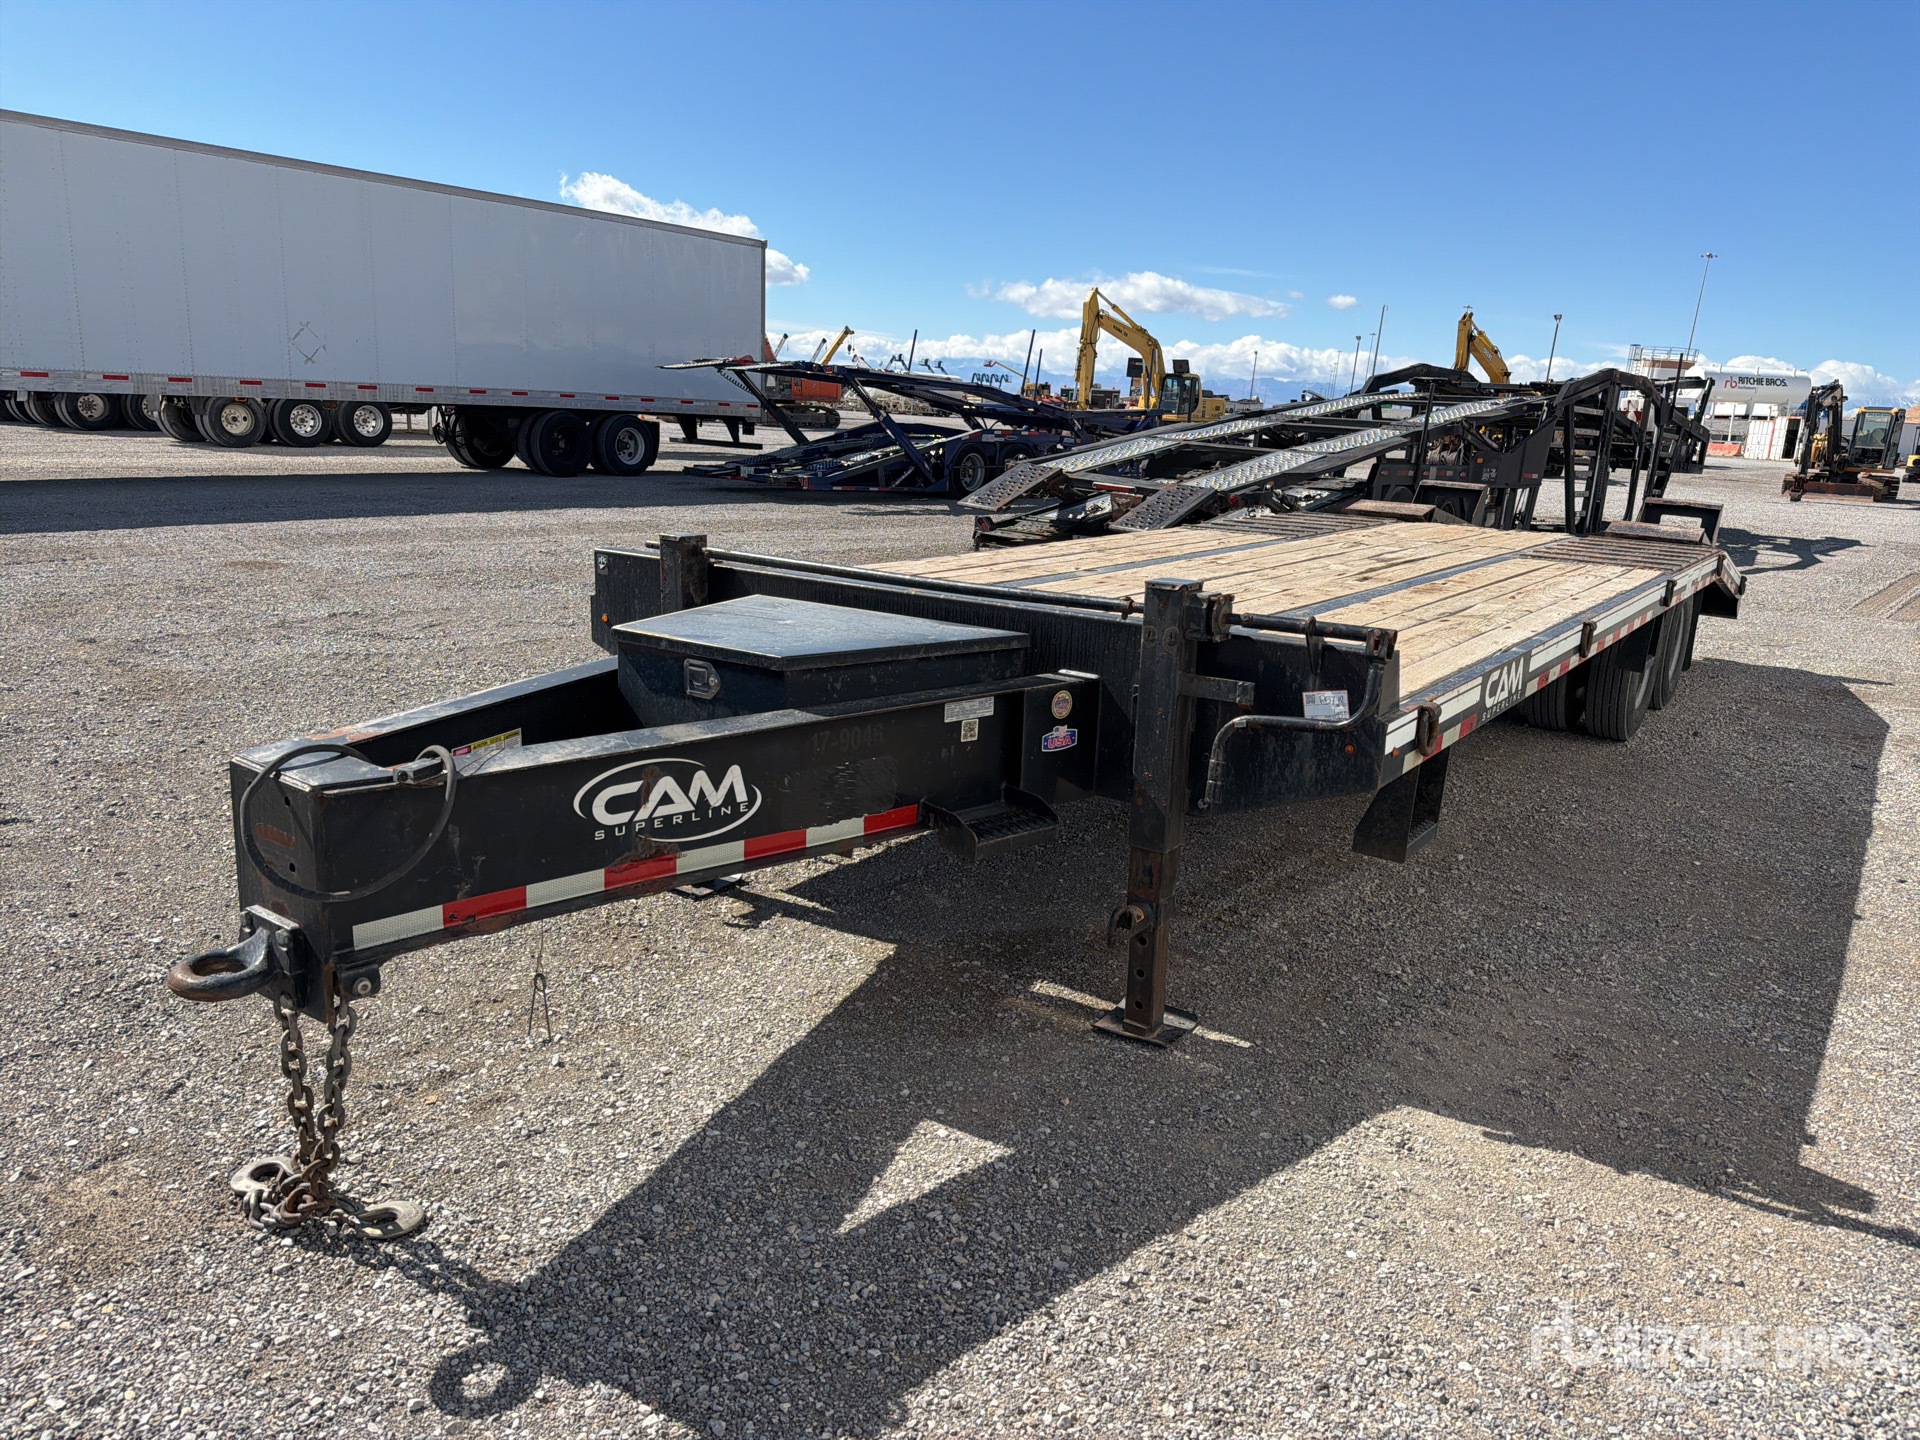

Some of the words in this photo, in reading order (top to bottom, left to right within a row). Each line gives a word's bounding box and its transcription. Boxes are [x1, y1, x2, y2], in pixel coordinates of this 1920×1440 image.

[1737, 376, 1765, 387] RITCHIE
[1765, 377, 1789, 388] BROS.
[1485, 656, 1524, 708] CAM
[1482, 690, 1522, 722] SUPERLINE
[1047, 735, 1073, 749] USA
[592, 764, 749, 826] CAM
[594, 801, 750, 841] SUPERLINE
